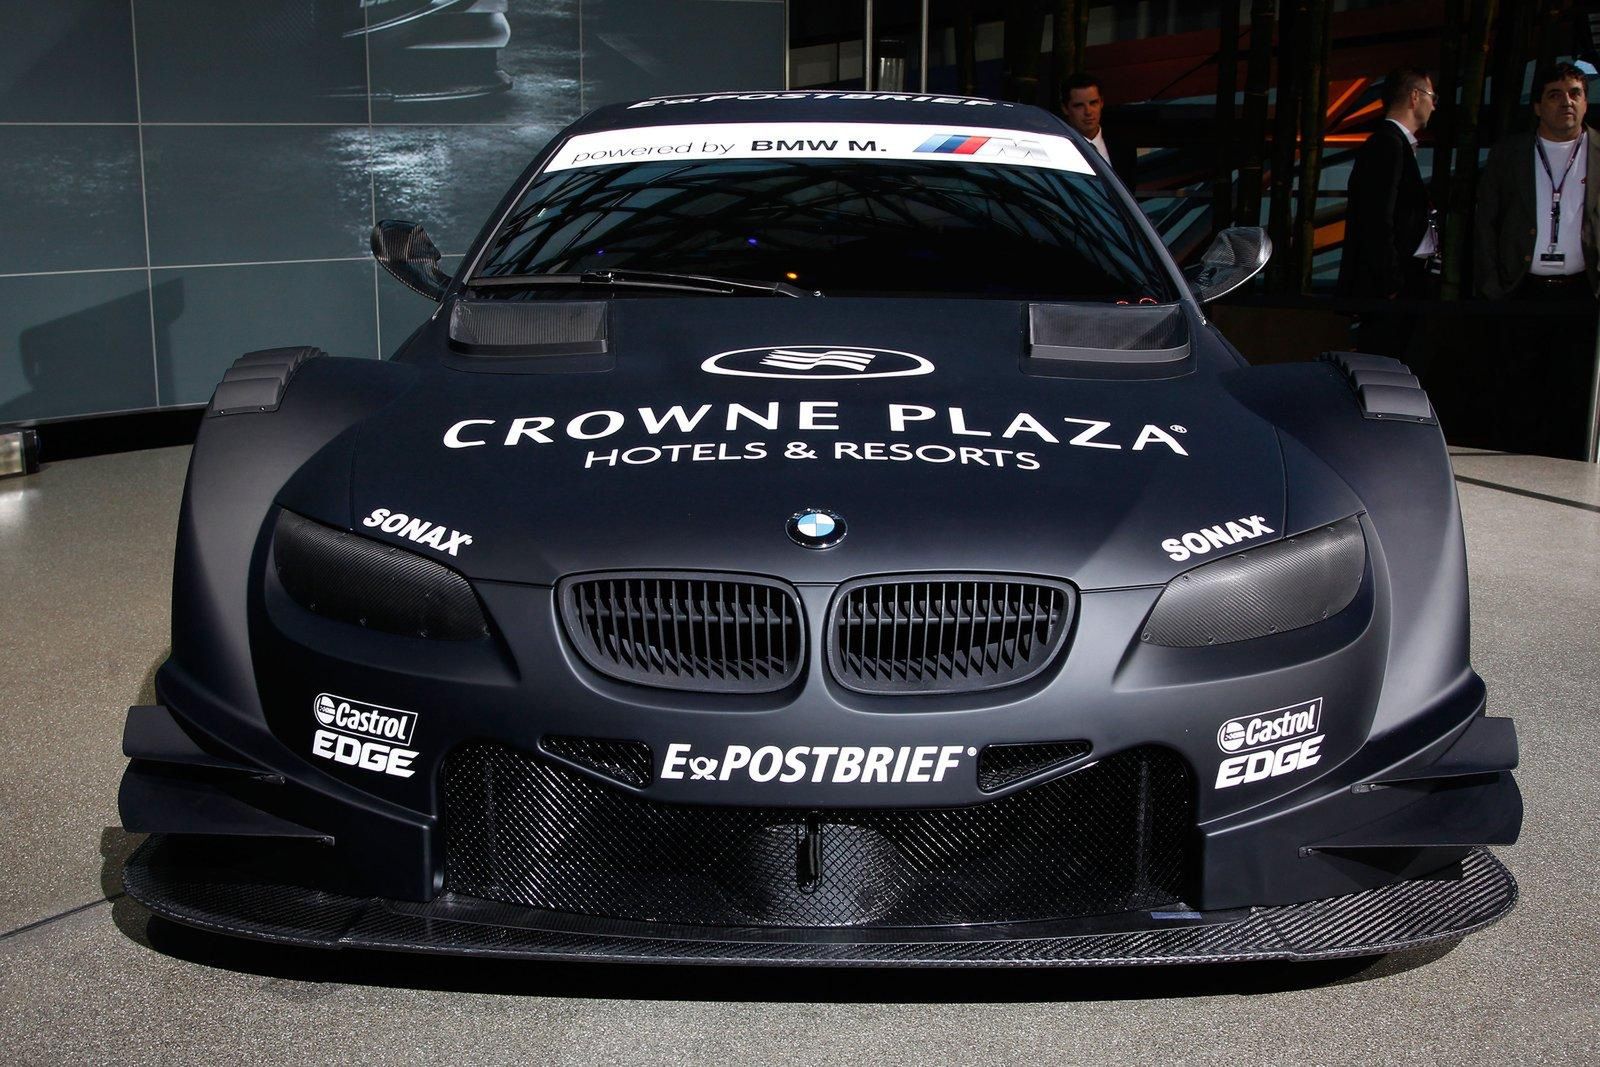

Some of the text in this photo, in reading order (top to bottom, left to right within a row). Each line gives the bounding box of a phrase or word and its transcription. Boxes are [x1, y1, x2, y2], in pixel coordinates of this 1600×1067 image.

[571, 142, 693, 165] powered
[701, 141, 735, 155] by
[751, 140, 838, 151] BMW
[443, 401, 839, 449] CROWNE
[584, 441, 1041, 470] HOTELS & RESORTS
[362, 508, 473, 556] SONAX
[1161, 514, 1275, 561] SONAX
[335, 702, 408, 740] Castrol
[1245, 704, 1316, 746] Castrol
[312, 729, 420, 778] EDGE
[1214, 734, 1326, 789] EDGE
